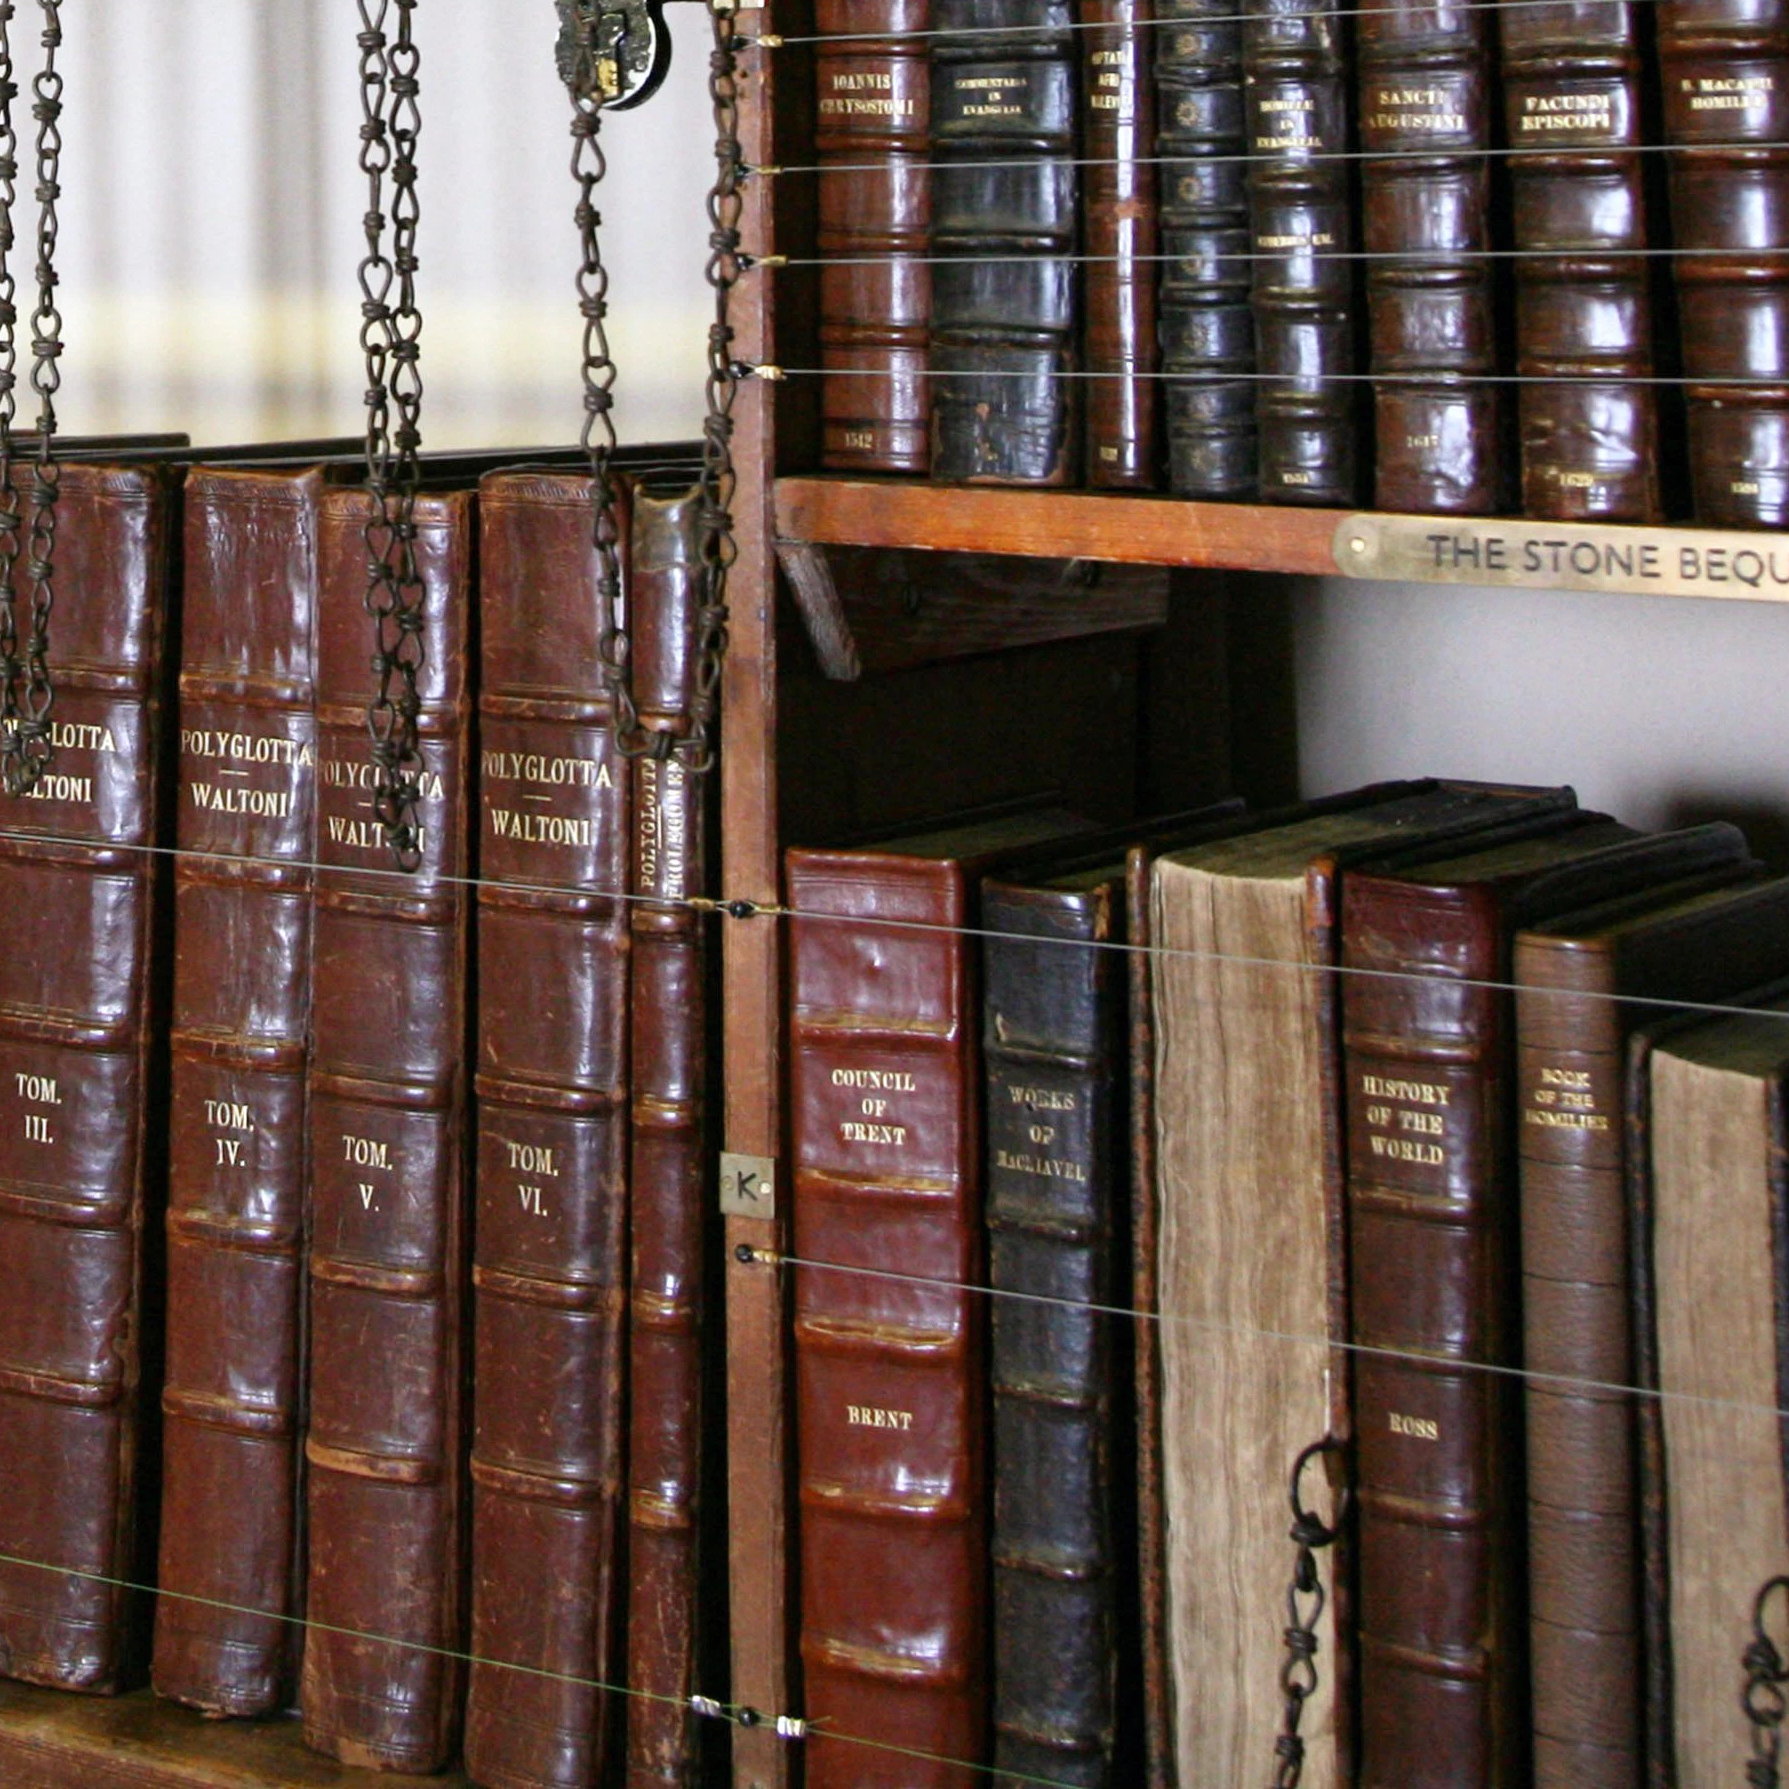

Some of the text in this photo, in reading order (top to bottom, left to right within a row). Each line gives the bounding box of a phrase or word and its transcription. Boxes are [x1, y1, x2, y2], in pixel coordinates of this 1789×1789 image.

[833, 73, 891, 89] IOANNIS
[1379, 90, 1446, 105] SANCTI
[1525, 94, 1610, 111] FACUNDI
[1368, 114, 1466, 130] AUGUSTINI
[1521, 114, 1610, 131] EPISCOPI
[1427, 535, 1507, 571] THE
[1523, 539, 1662, 579] STONE
[180, 729, 314, 767] POLYGLOTTA
[481, 750, 613, 788] POLYGLOTTA
[191, 782, 288, 818] WALTONI
[328, 815, 426, 853] WALTI
[491, 809, 590, 846] WALTONI
[15, 1072, 61, 1106] TOM.
[831, 1068, 917, 1092] COUNCIL
[1363, 1075, 1450, 1106] HISTORY
[1541, 1067, 1591, 1088] BOOK
[861, 1097, 887, 1119] OF
[1008, 1085, 1076, 1110] WORKS
[1534, 1089, 1595, 1108] OF THE
[24, 1115, 54, 1145] III.
[204, 1099, 255, 1132] TOM.
[1366, 1105, 1444, 1136] OF THE
[841, 1122, 907, 1146] TRENT
[1029, 1123, 1055, 1146] OF
[215, 1138, 246, 1168] IV.
[342, 1134, 394, 1172] TOM.
[508, 1140, 559, 1177] TOM.
[1370, 1137, 1445, 1165] WORLD
[358, 1183, 380, 1213] V.
[517, 1184, 548, 1218] VI.
[737, 1171, 758, 1201] K
[847, 1405, 913, 1431] BRENT
[1389, 1413, 1438, 1441] ROSS
